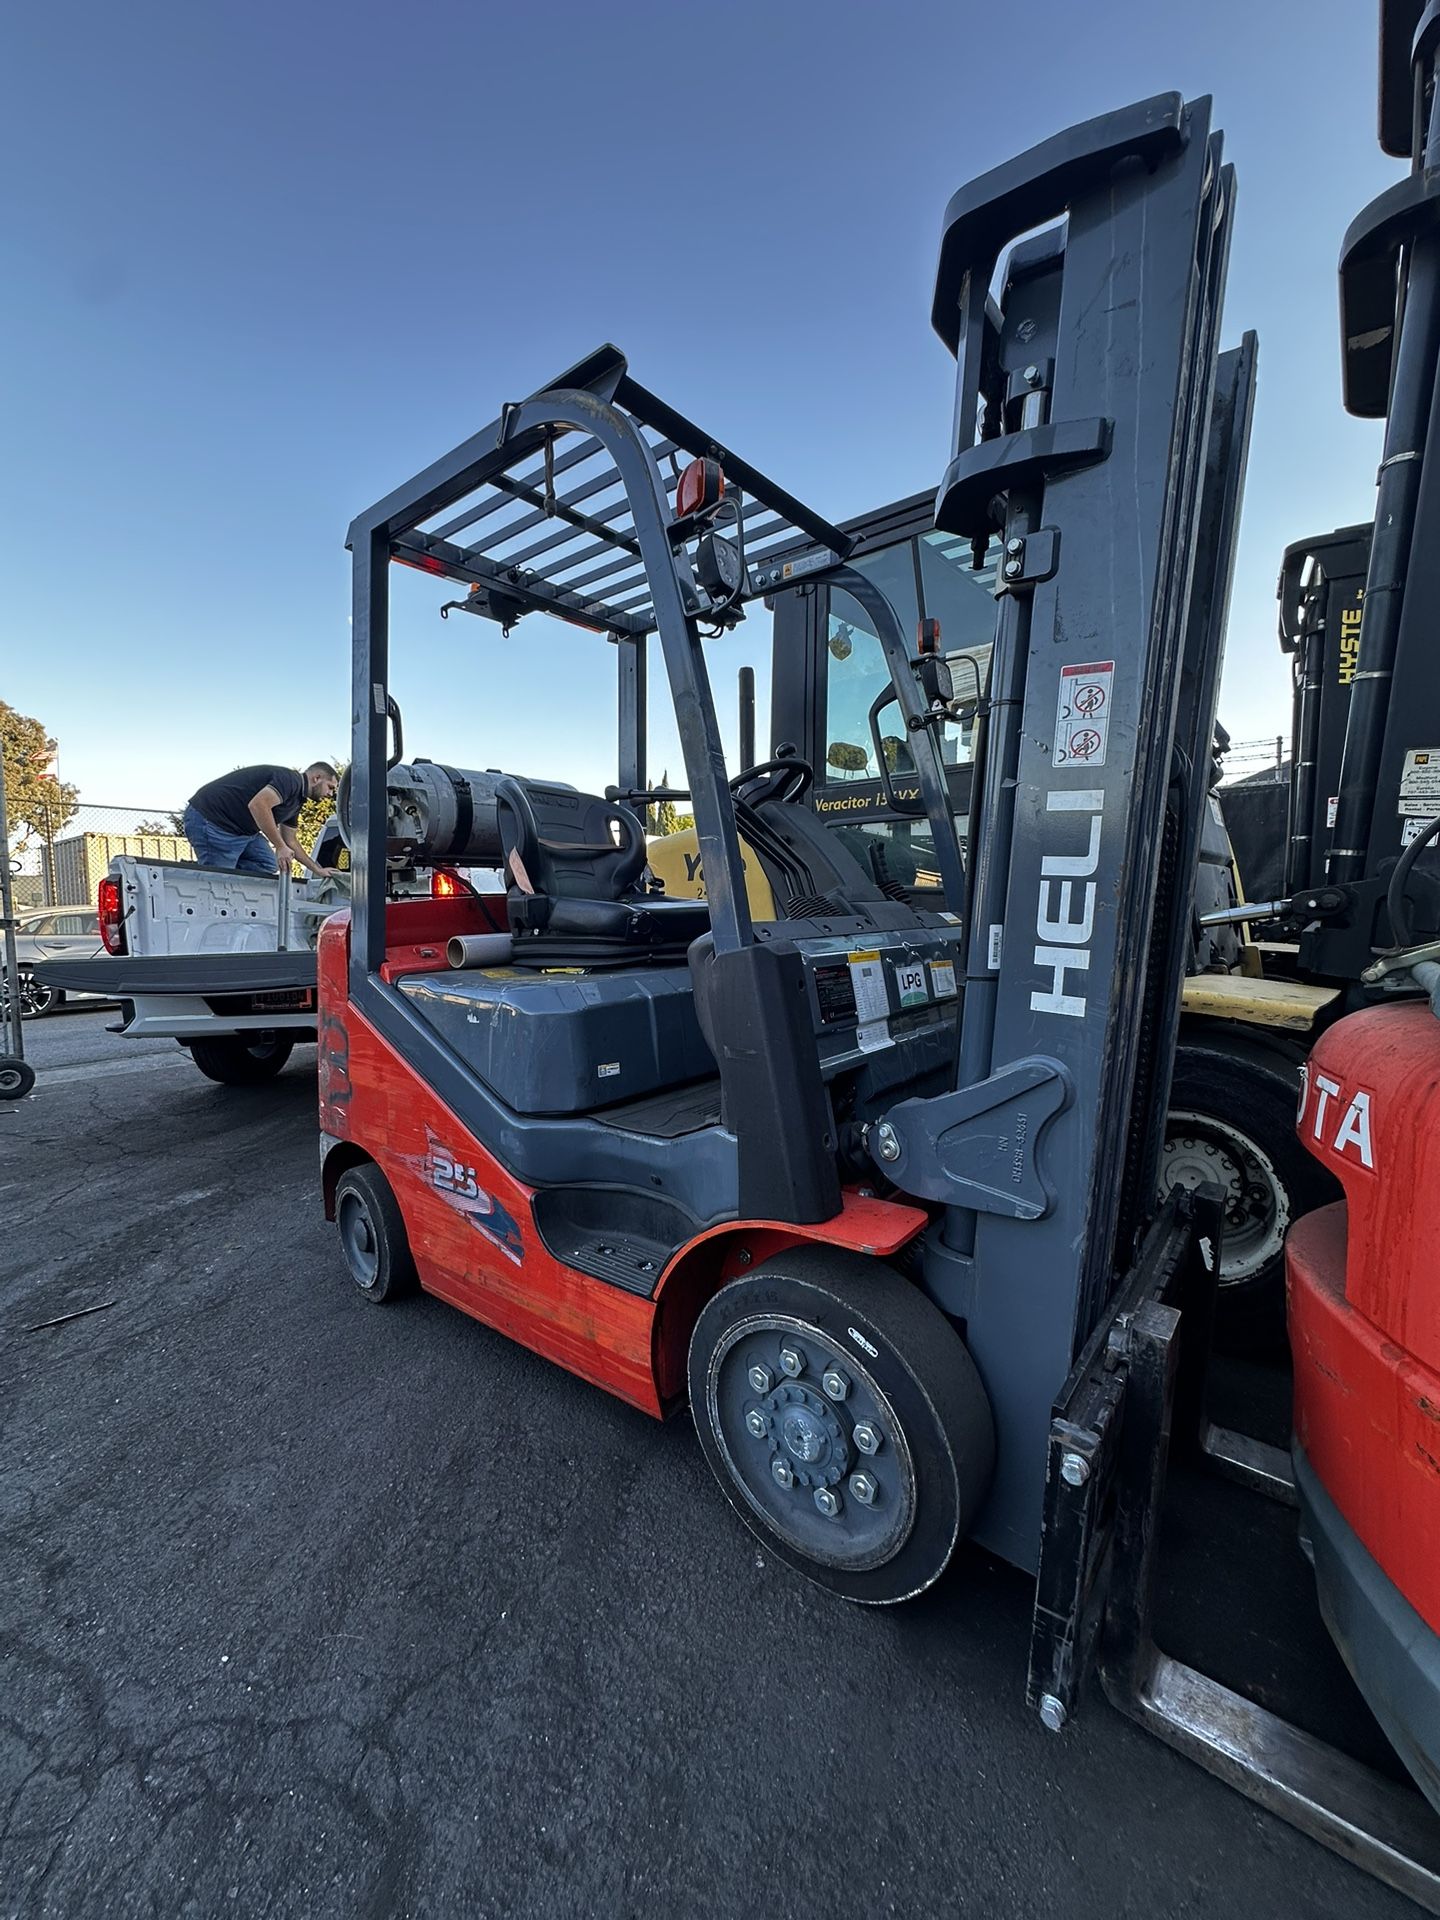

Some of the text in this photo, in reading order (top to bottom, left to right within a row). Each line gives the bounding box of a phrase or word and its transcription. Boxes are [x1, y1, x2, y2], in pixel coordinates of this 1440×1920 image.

[815, 796, 872, 812] Veracitor
[1030, 789, 1105, 1018] HELI
[901, 972, 922, 991] LPG
